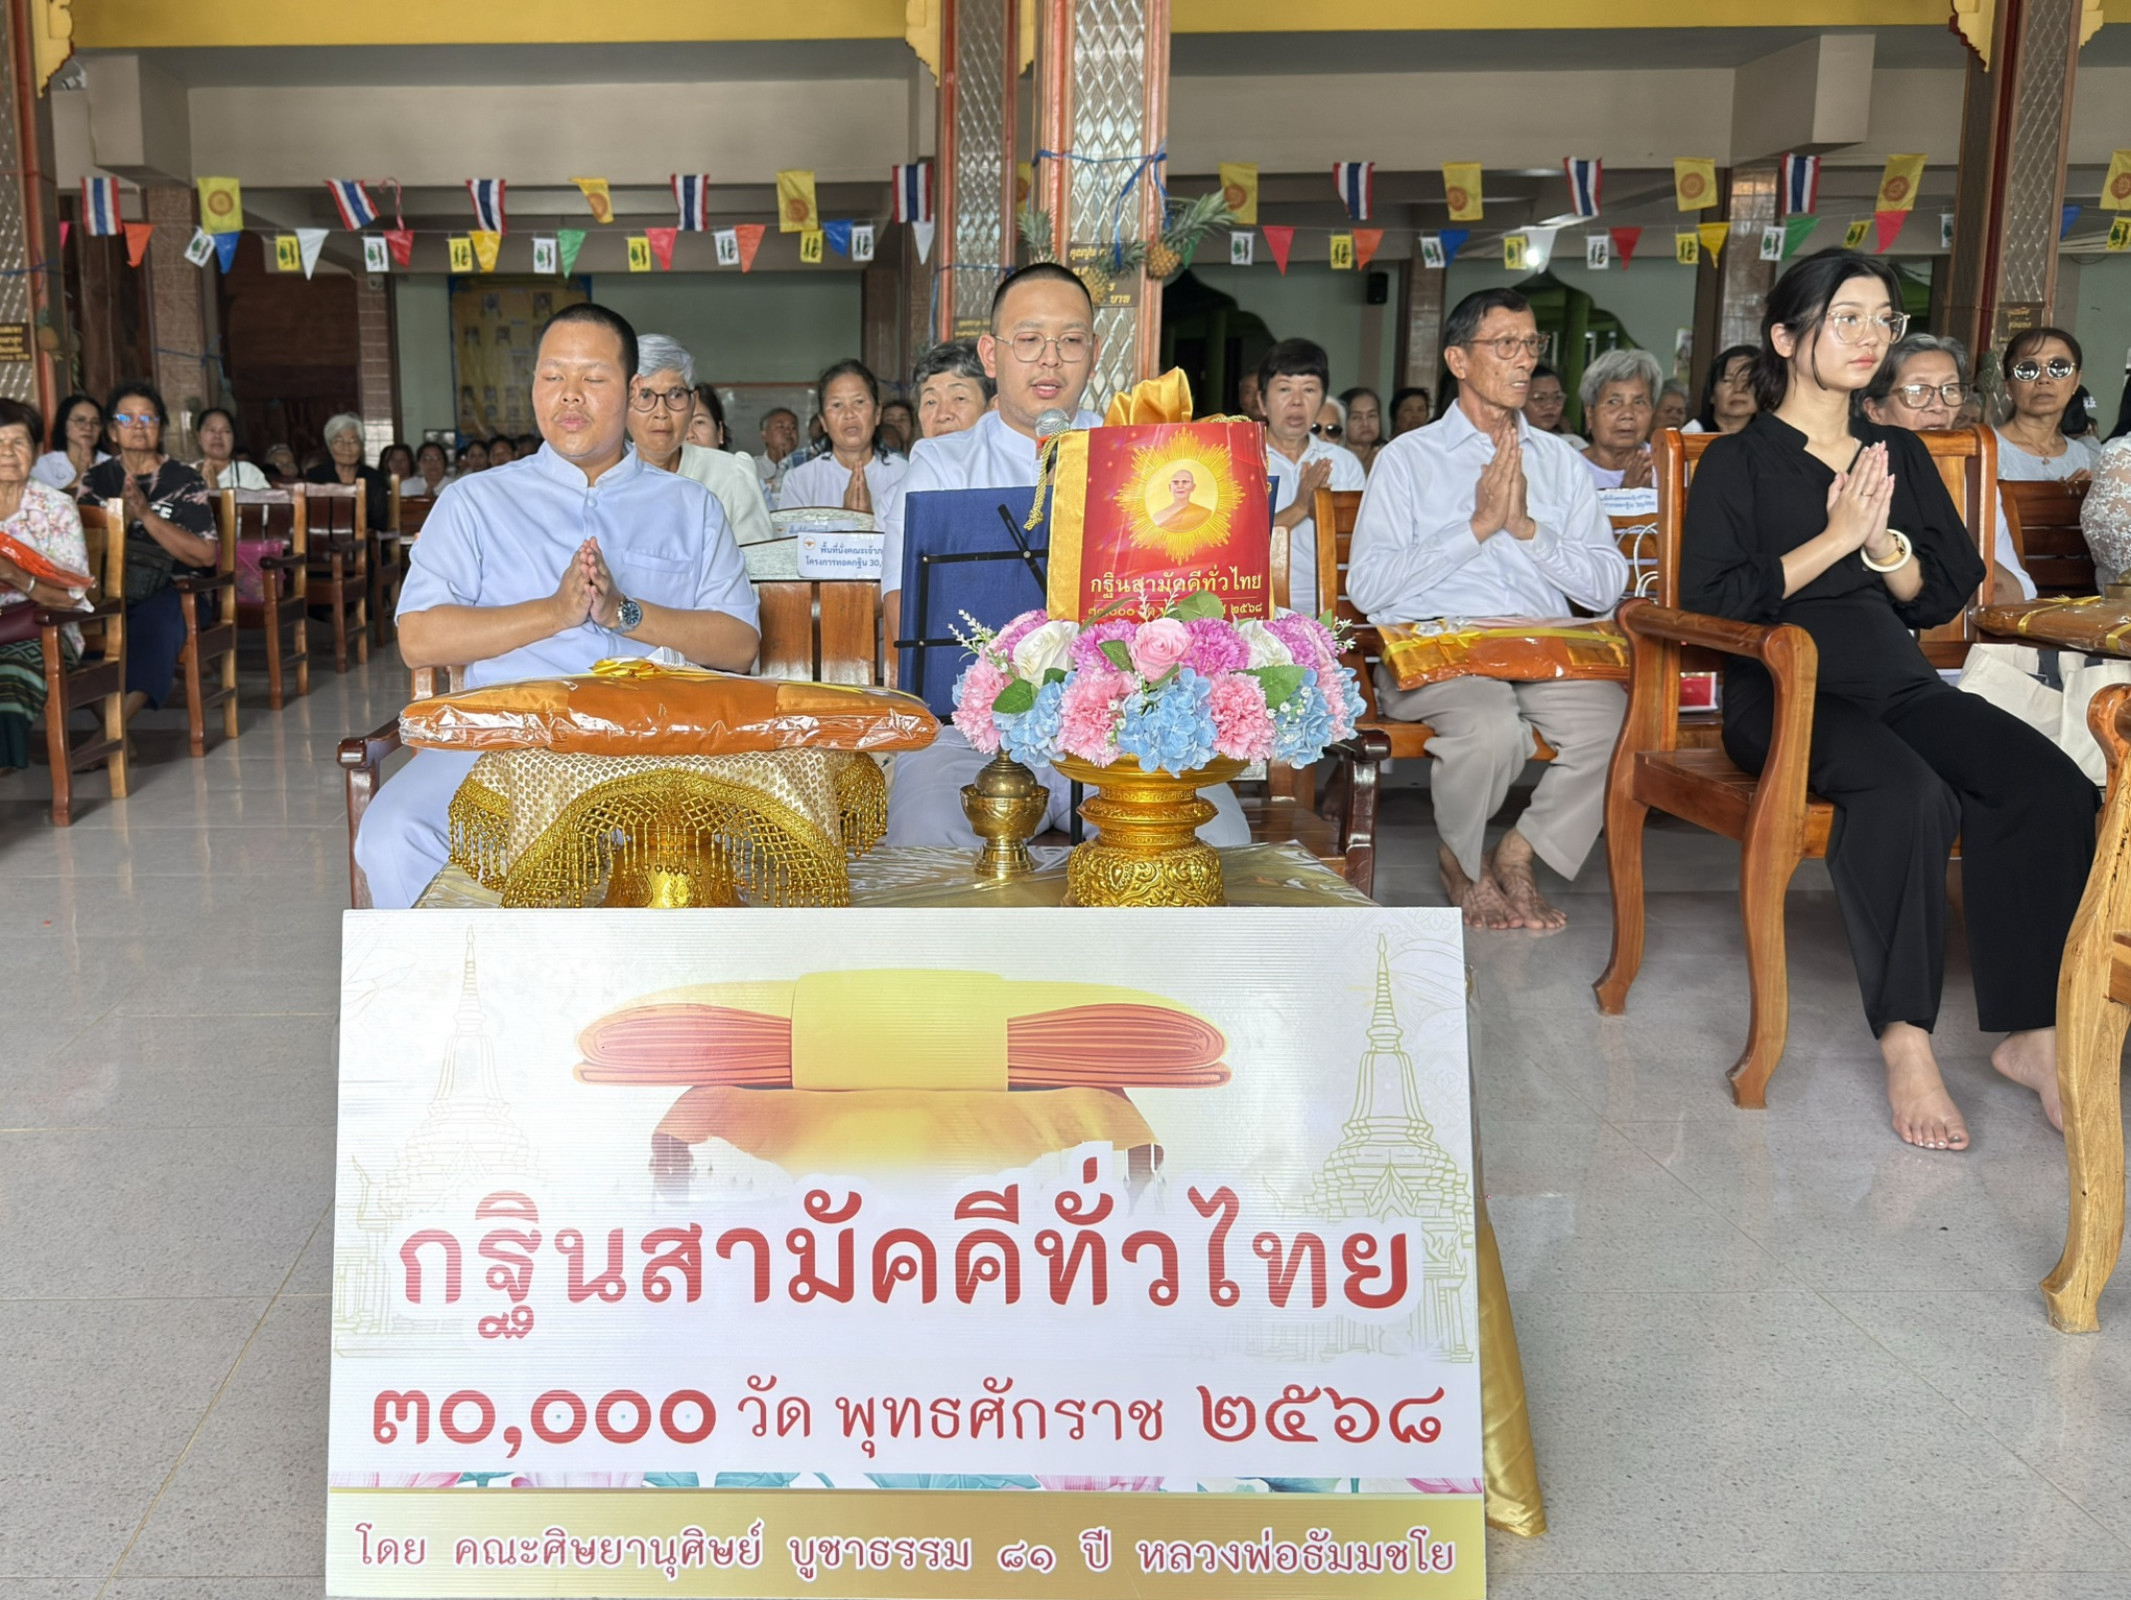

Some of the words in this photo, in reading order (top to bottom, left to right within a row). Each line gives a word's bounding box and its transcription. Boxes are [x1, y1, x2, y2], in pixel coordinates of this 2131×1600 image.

[806, 555, 867, 569] โครงการทอดกฐิน
[1090, 564, 1262, 598] กฐินสามัคคีทั่วไทย
[1230, 602, 1263, 614] ๒๕๖๘
[399, 1157, 1410, 1340] กฐินสามัคคีทั่วไทย
[373, 1389, 717, 1459] ๓๐,๐๐๐
[737, 1374, 812, 1438] วัด
[835, 1376, 1164, 1459] พุทธศักราช
[1196, 1384, 1446, 1445] ๒๕๖๘
[355, 1523, 426, 1566] โดย
[455, 1518, 763, 1579] คณะศิษยานุศิษย์
[789, 1537, 971, 1579] บูชาธรรม
[998, 1544, 1056, 1570] ๘๑
[1082, 1528, 1111, 1570] ปี
[1138, 1528, 1456, 1573] หลวงพ่อธัมมชโย
